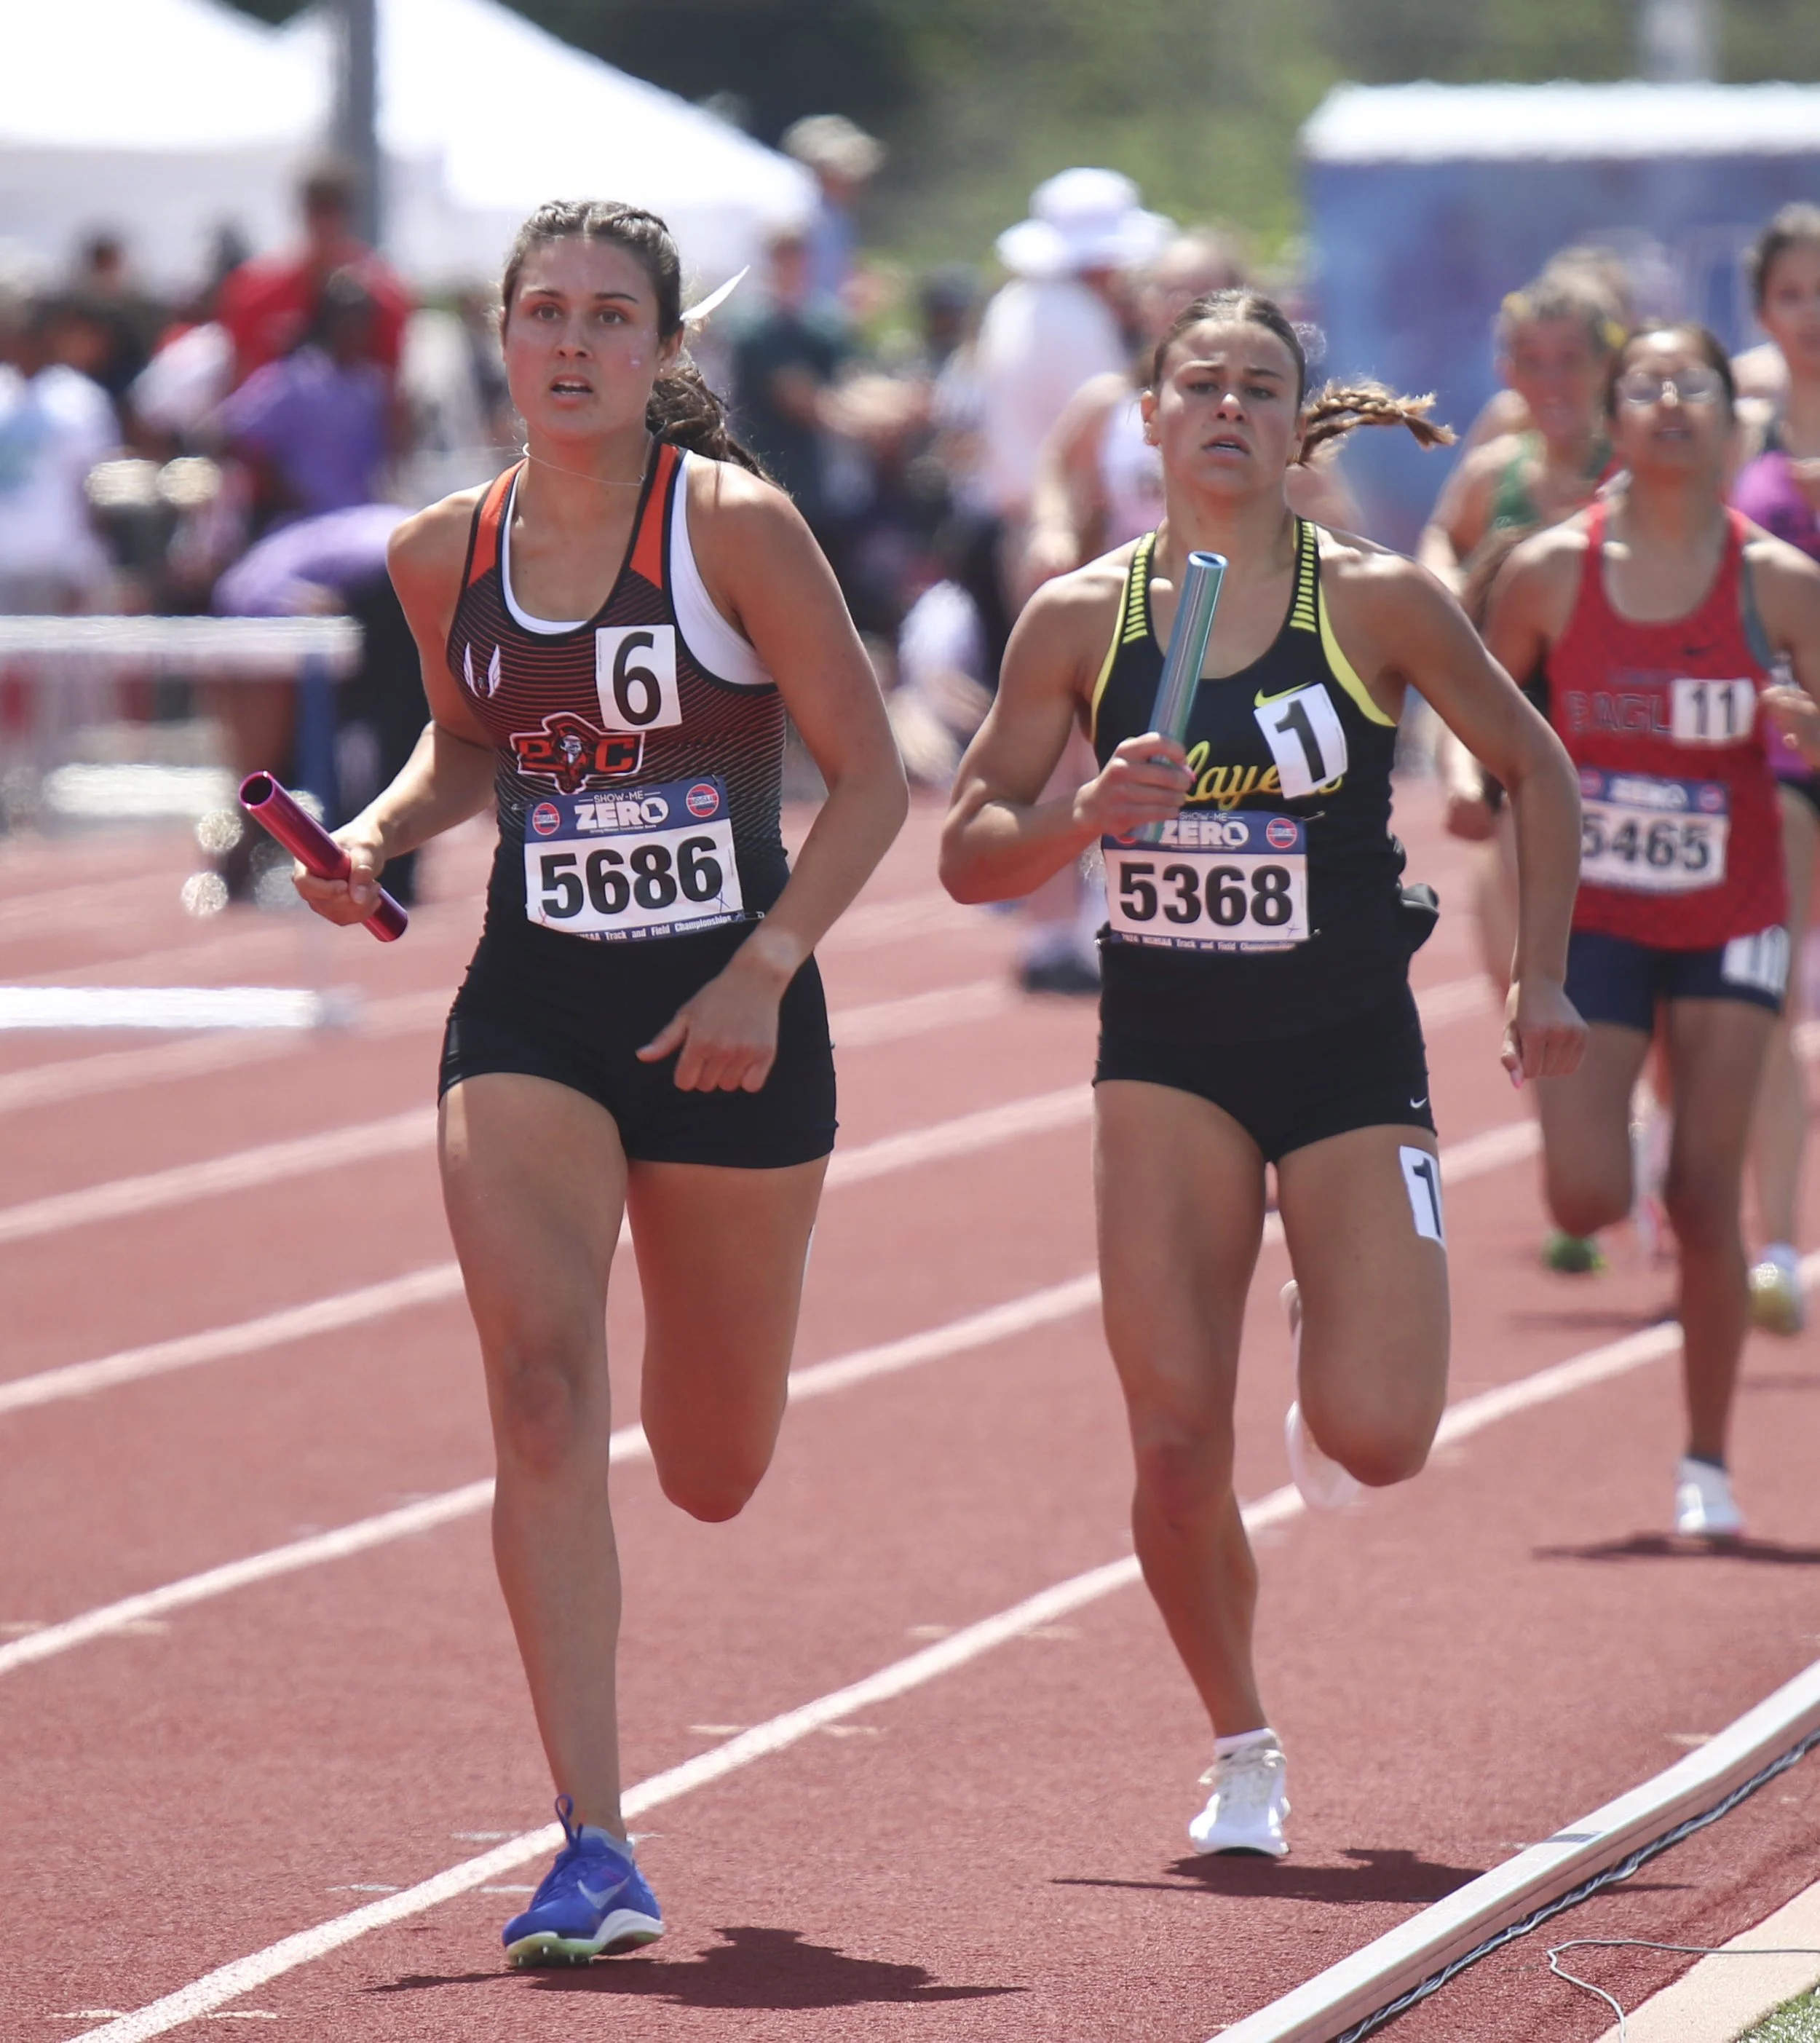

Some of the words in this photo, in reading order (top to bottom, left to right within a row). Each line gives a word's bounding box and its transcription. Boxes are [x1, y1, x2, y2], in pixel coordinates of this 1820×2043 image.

[613, 631, 662, 726] 6
[1691, 684, 1737, 735] 11
[1274, 699, 1326, 783] 1
[574, 797, 669, 831] ZERO
[594, 790, 644, 802] SHOW-ME
[1159, 820, 1249, 847] ZERO
[540, 836, 723, 919] 5686
[1120, 861, 1293, 926] 5368
[605, 930, 627, 941] Track
[631, 928, 646, 938] and
[652, 923, 670, 936] Field
[675, 914, 732, 933] Championships
[1176, 938, 1195, 949] Track
[1413, 1157, 1441, 1238] 1
